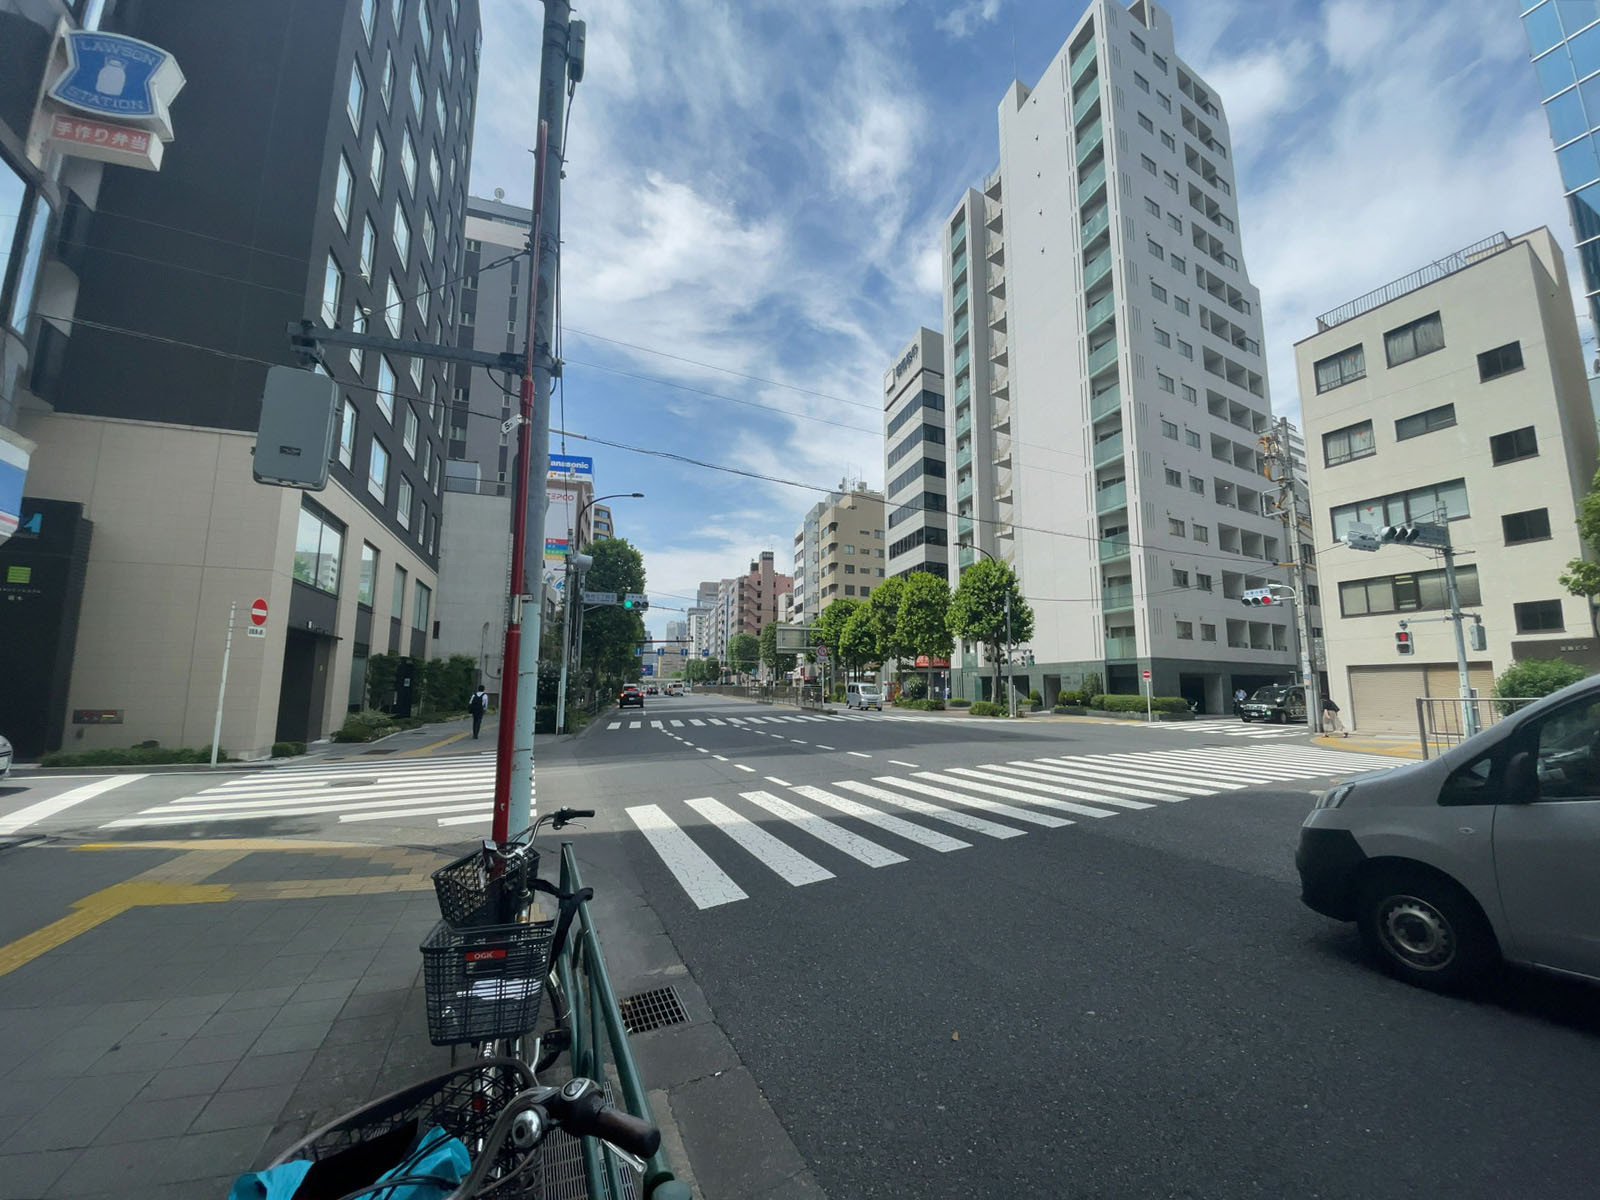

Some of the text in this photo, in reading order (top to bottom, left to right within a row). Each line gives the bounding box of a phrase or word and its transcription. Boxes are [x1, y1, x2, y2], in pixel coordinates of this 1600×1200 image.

[81, 41, 155, 65] LAWSON
[65, 86, 143, 109] STATION
[57, 122, 147, 150] 手作り弁当
[550, 460, 590, 469] anasonic
